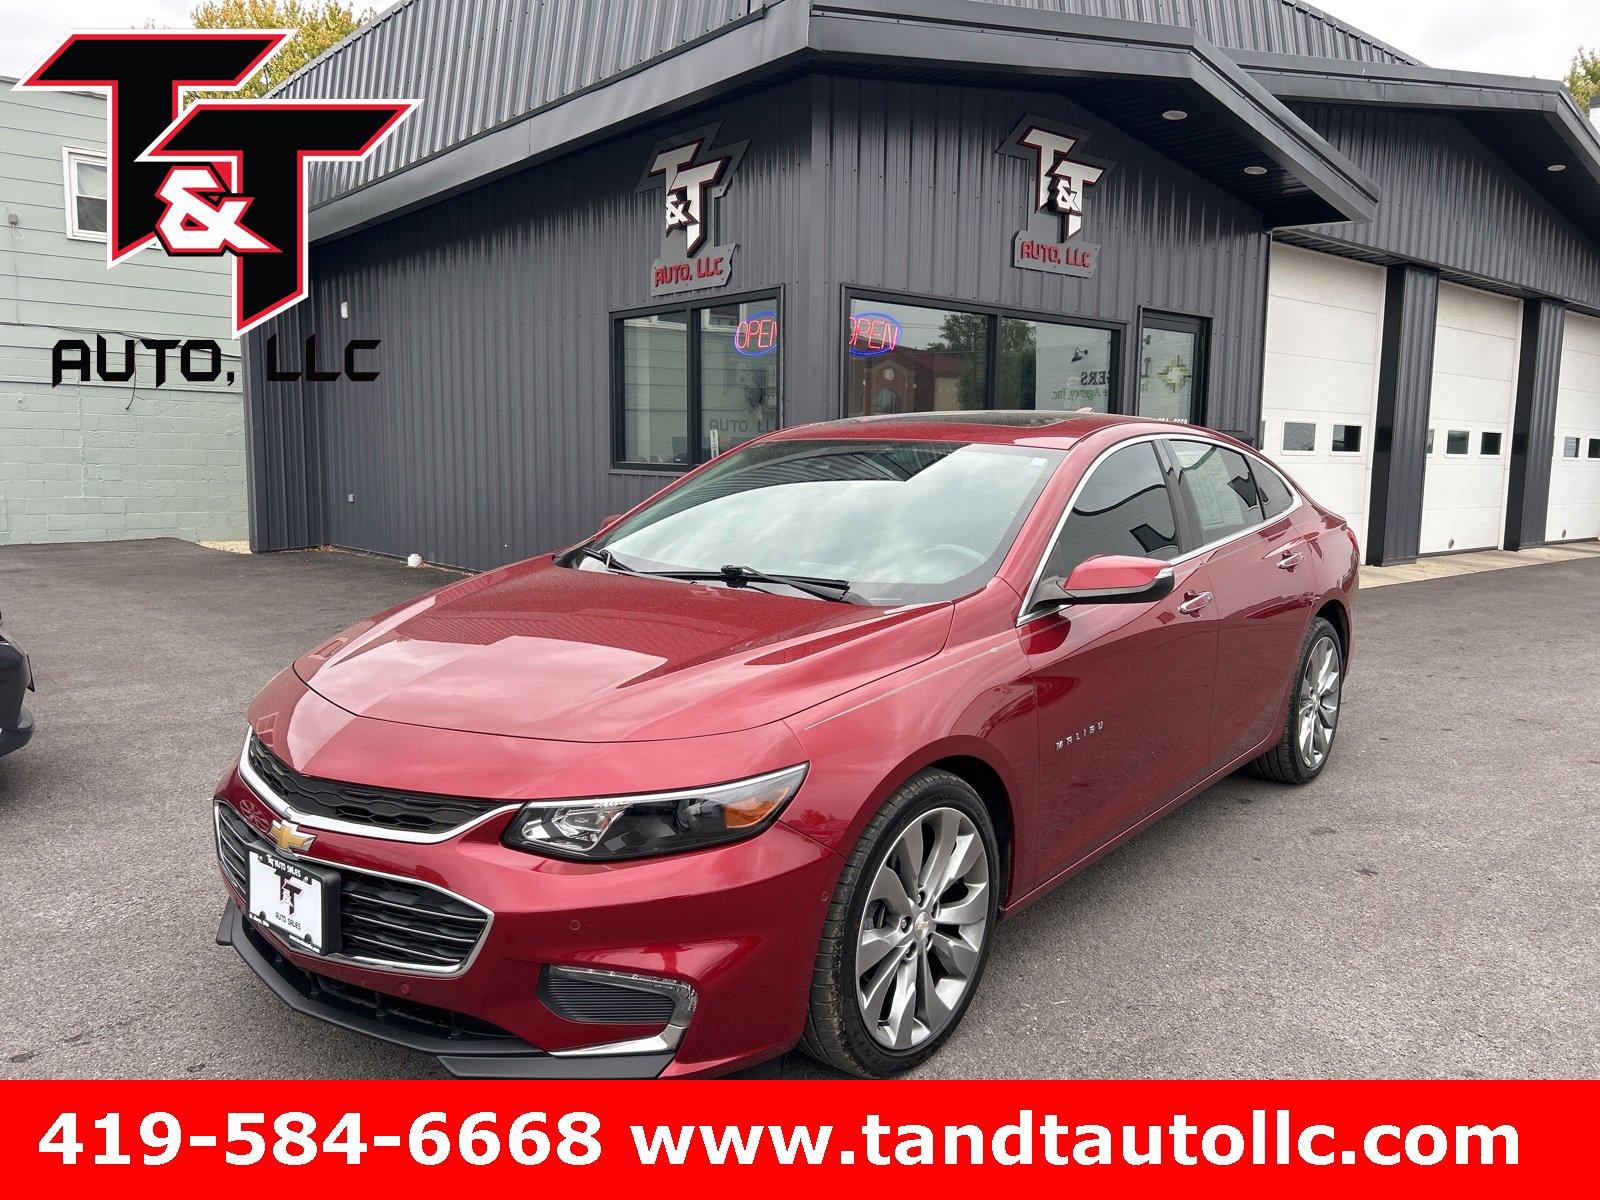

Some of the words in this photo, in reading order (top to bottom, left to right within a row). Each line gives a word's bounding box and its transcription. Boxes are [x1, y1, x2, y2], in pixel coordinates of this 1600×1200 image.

[1016, 126, 1106, 243] T&T
[648, 138, 731, 258] T&T
[696, 257, 724, 279] LLC
[1065, 246, 1092, 268] LLC
[1055, 720, 1104, 752] MALIBU
[286, 865, 302, 878] SALES
[275, 911, 287, 923] AUTO
[287, 917, 302, 931] SALES
